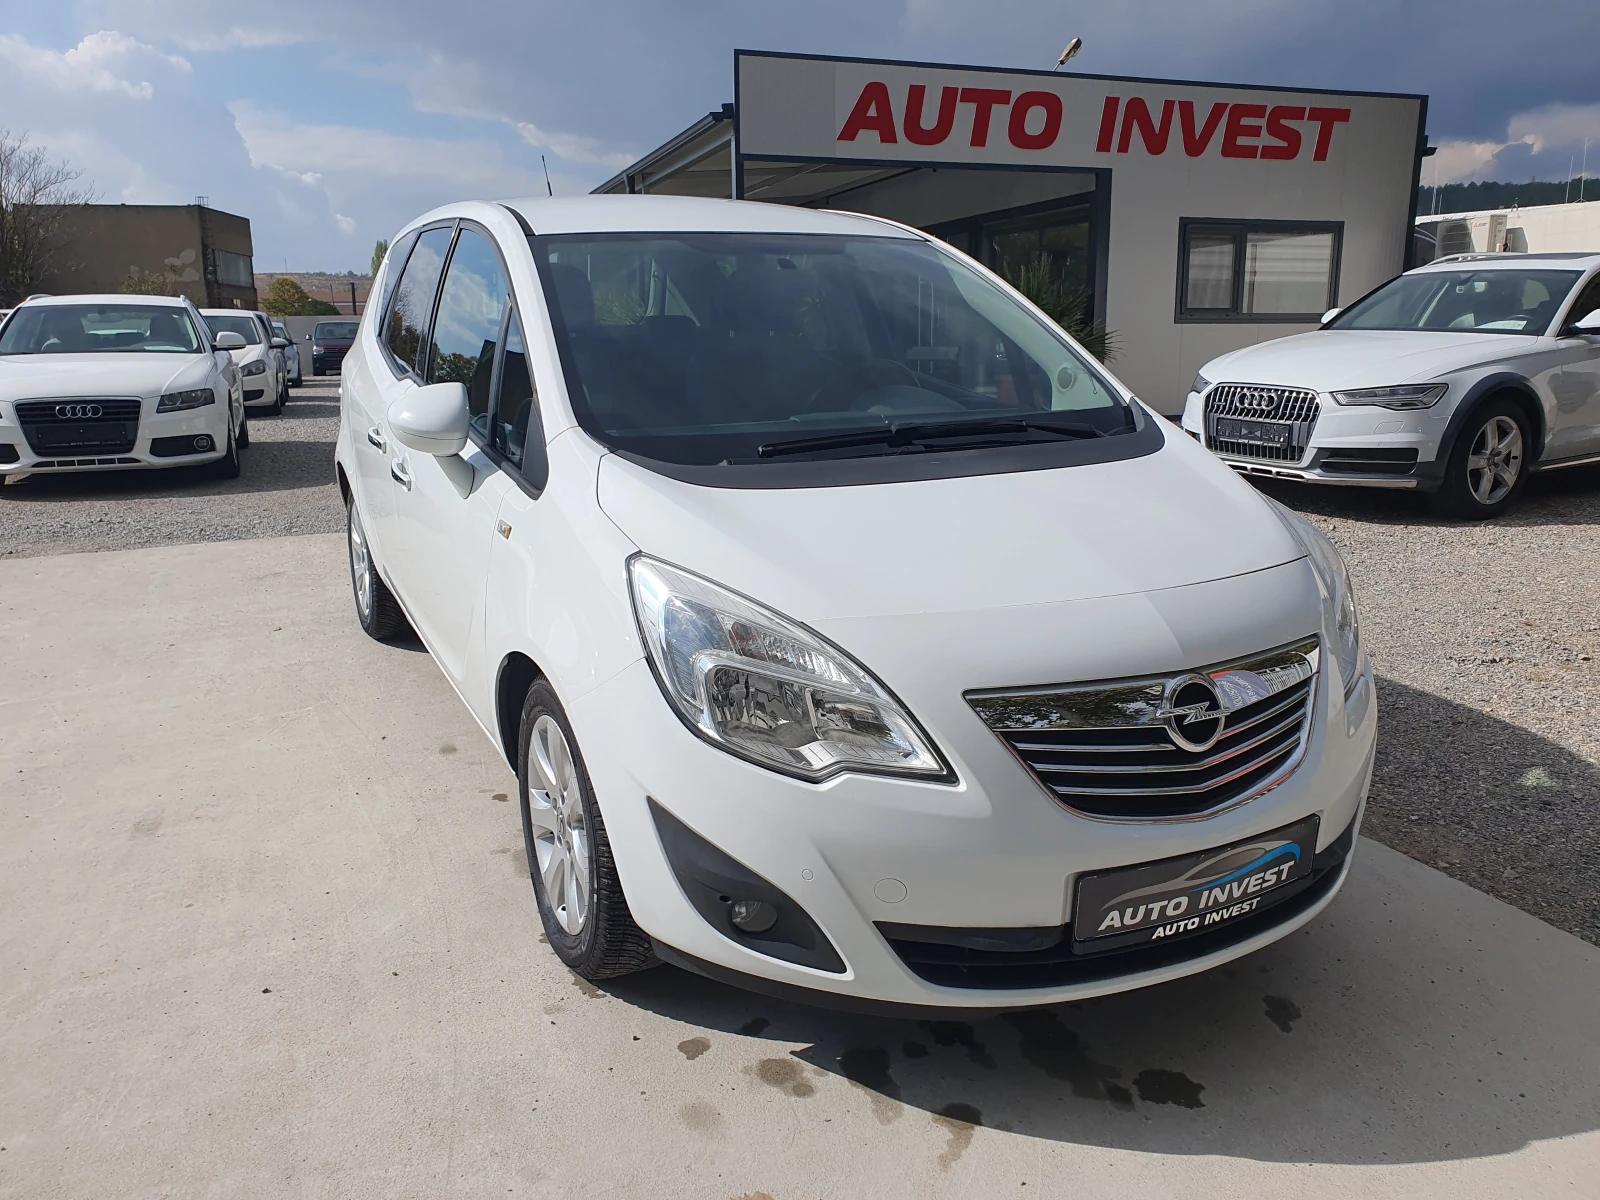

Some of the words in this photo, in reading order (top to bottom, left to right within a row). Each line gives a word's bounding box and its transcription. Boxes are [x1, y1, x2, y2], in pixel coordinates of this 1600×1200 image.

[837, 81, 1063, 150] AUTO
[1095, 96, 1351, 162] INVEST
[1097, 896, 1189, 931] AUTO
[1199, 861, 1295, 909] INVEST
[1151, 917, 1200, 940] AUTO
[1204, 897, 1261, 926] INVEST
